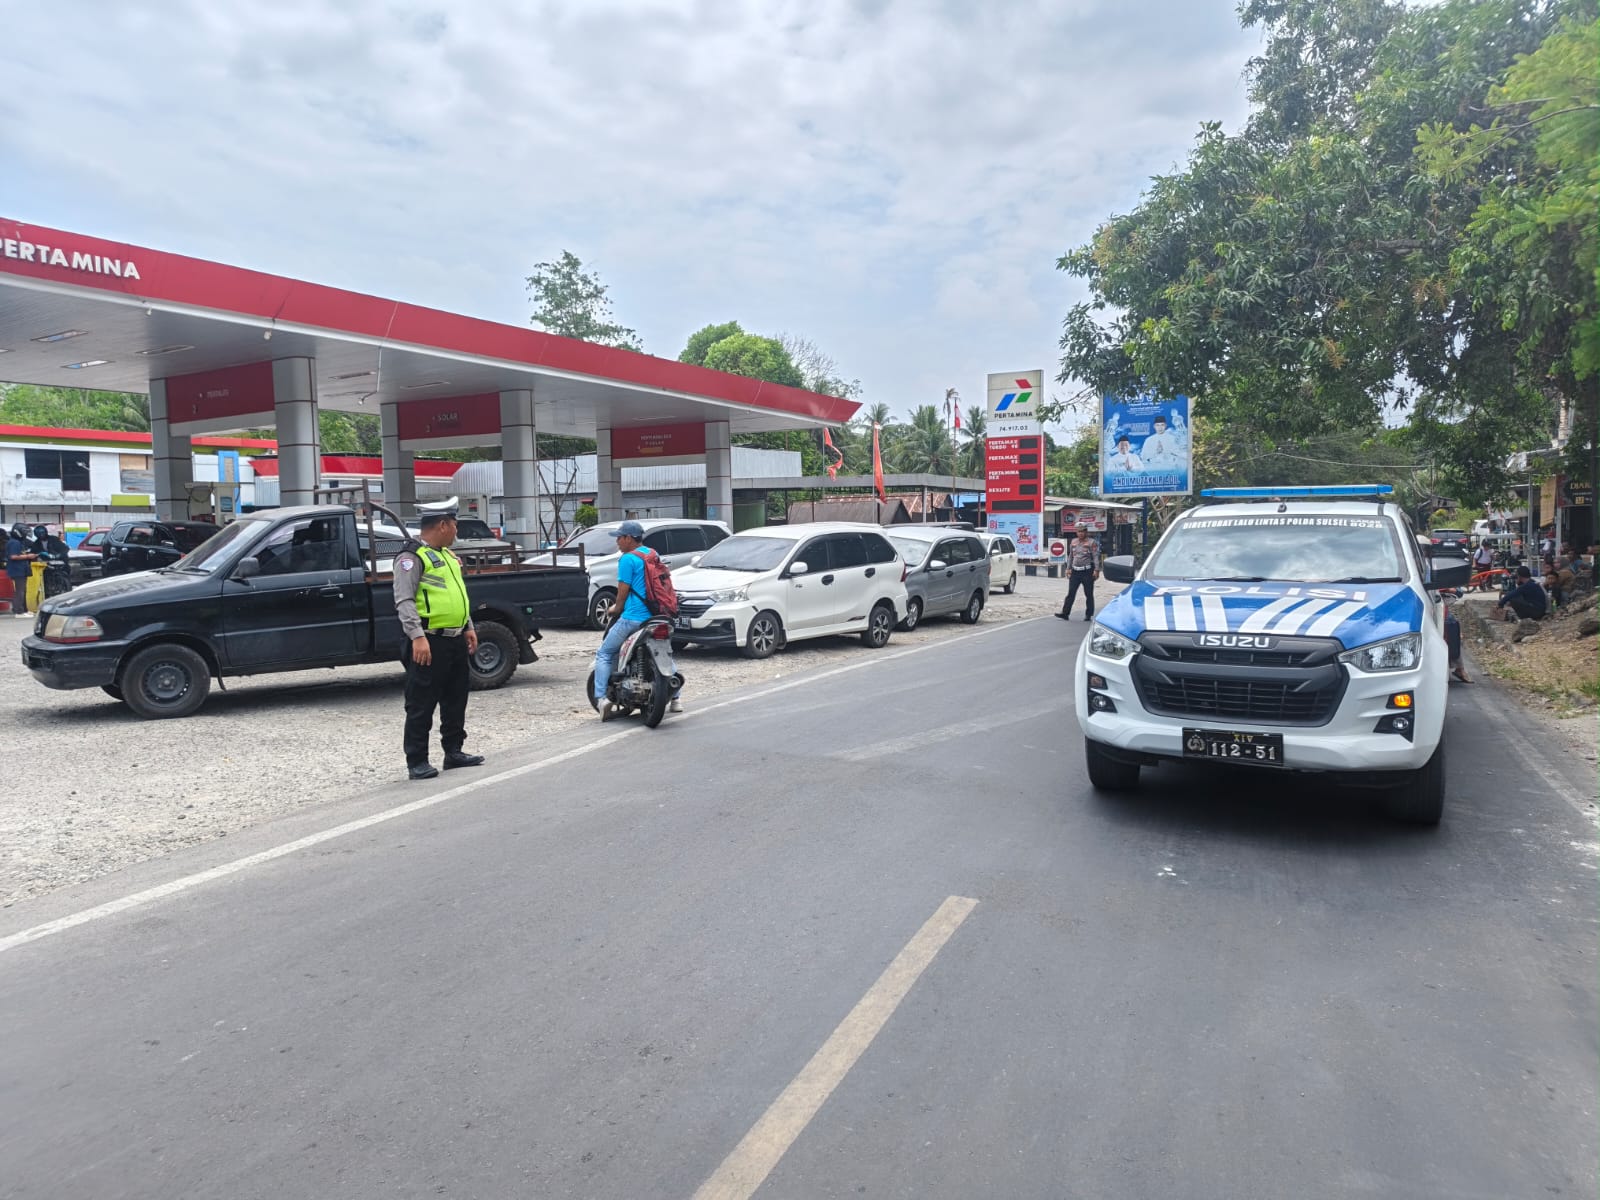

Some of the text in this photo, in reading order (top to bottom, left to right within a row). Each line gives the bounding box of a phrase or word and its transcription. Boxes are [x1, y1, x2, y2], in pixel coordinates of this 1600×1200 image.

[994, 411, 1033, 419] PERTAMINA
[1183, 519, 1231, 529] DIREKTORAT
[1233, 518, 1253, 526] LALU
[1254, 518, 1285, 526] LINTAS
[1316, 518, 1348, 526] SULSEL
[1152, 586, 1367, 602] POLISI
[1200, 634, 1270, 648] ISUZU
[1233, 734, 1254, 743] XIV
